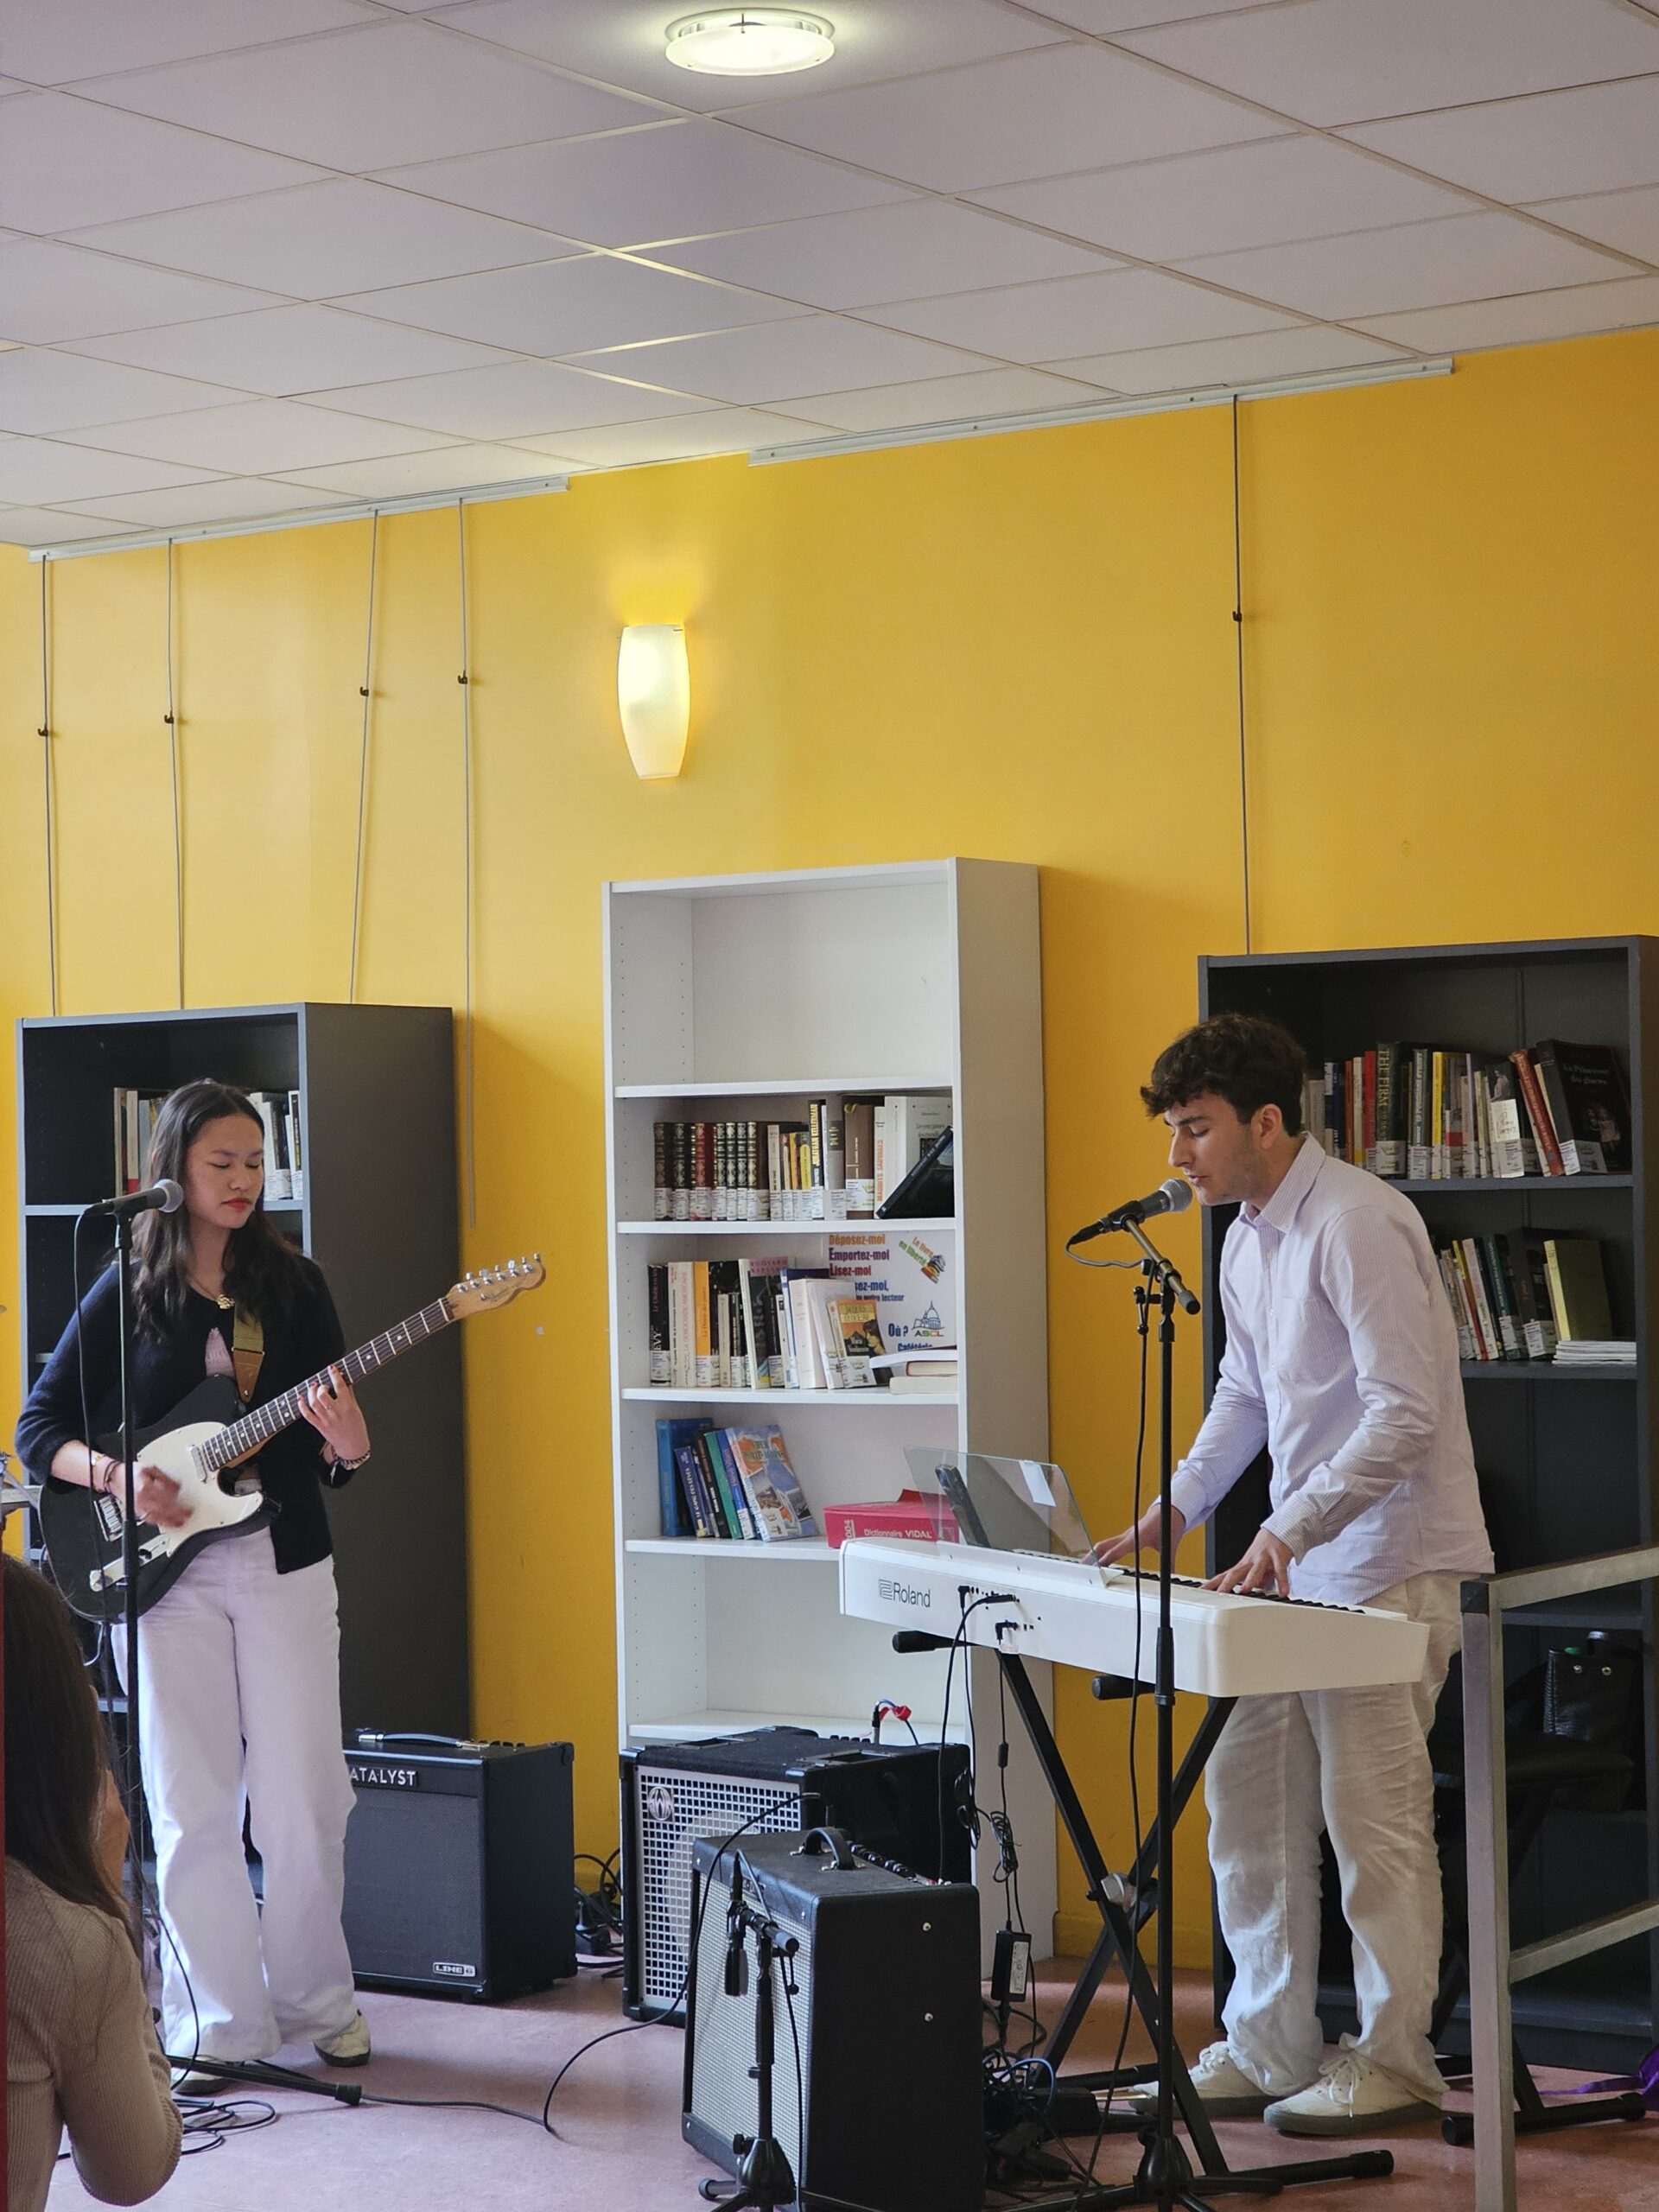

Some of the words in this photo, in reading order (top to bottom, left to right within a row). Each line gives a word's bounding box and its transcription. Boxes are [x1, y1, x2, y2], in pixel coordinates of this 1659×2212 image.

[829, 1247, 890, 1262] Emportez-moi
[830, 1262, 872, 1276] Lisez-moi
[888, 1323, 901, 1338] Où
[903, 1325, 909, 1337] ?
[863, 1528, 903, 1538] Dictionnaire
[905, 1529, 932, 1539] VIDAL
[893, 1581, 931, 1608] Roland
[350, 1767, 416, 1786] ATALYST
[435, 1964, 463, 1974] LINE
